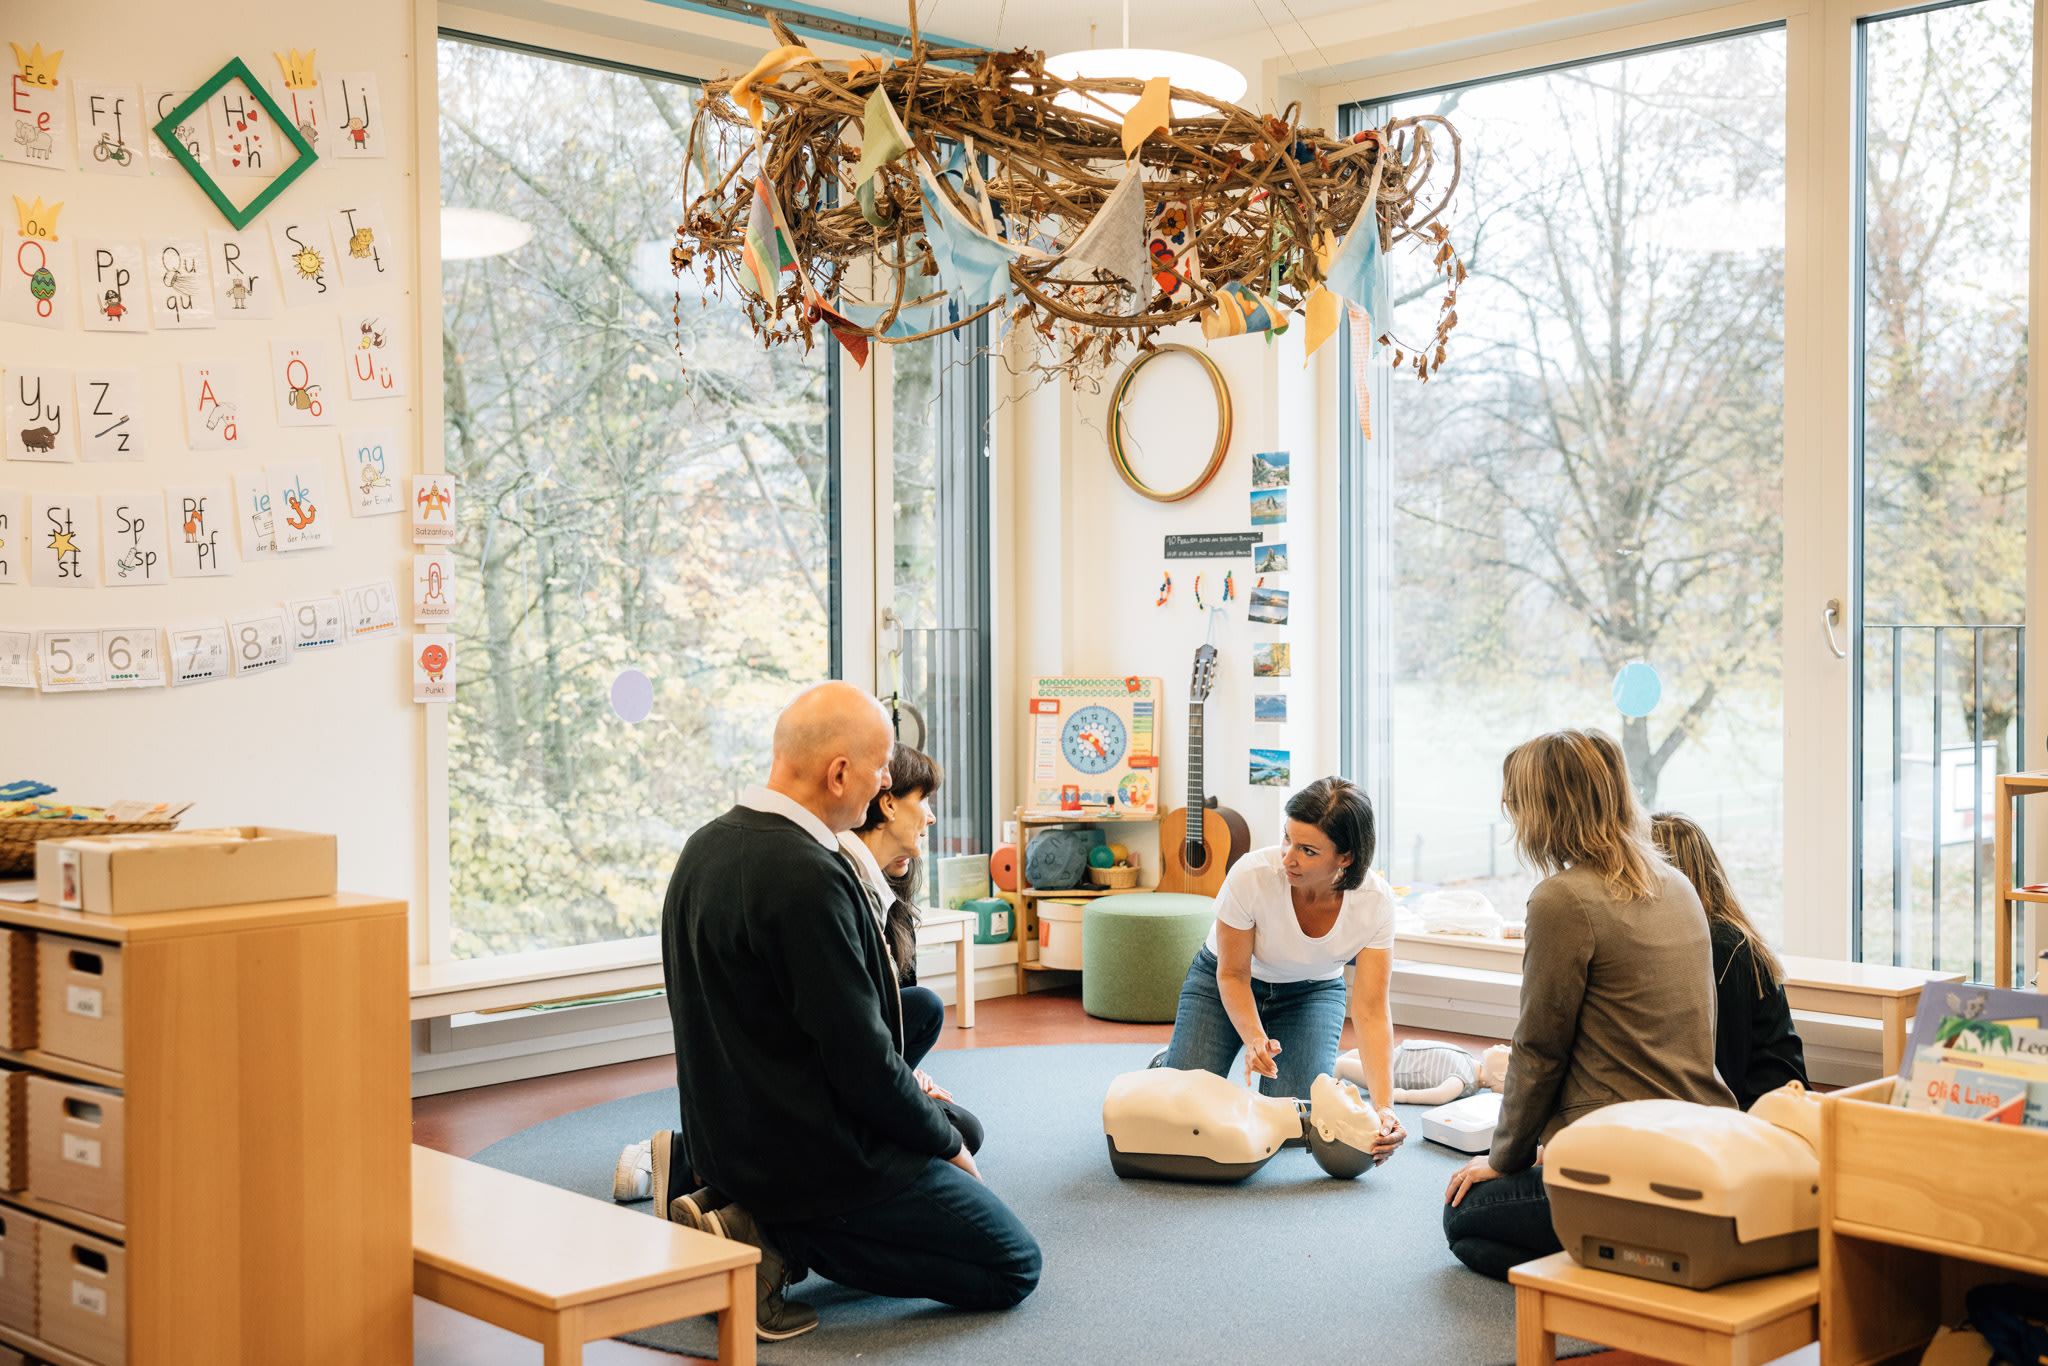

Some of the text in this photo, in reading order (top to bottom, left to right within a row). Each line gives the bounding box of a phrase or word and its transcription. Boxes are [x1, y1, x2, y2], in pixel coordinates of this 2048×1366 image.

[25, 65, 47, 85] Ee
[223, 95, 247, 127] H
[246, 136, 261, 168] h
[26, 220, 46, 237] Oo
[162, 247, 197, 274] Qu
[166, 295, 193, 323] qu
[358, 445, 385, 473] ng
[252, 488, 271, 512] ie
[283, 474, 311, 506] nk
[46, 507, 76, 538] St
[116, 506, 145, 545] Sp
[183, 497, 207, 537] Pf
[415, 527, 454, 538] Satzanfang
[58, 549, 82, 578] st
[197, 530, 219, 570] pf
[134, 551, 157, 579] sp
[353, 588, 380, 615] 10
[421, 607, 450, 615] Abstand
[297, 605, 317, 639] 9
[50, 638, 74, 674] 5
[108, 636, 131, 670] 6
[181, 635, 202, 670] 7
[241, 627, 262, 661] 8
[425, 686, 444, 694] Punkt
[1114, 736, 1119, 744] 3
[1102, 756, 1107, 764] 5
[1927, 1080, 1948, 1099] Oli
[1950, 1083, 1961, 1105] &
[1964, 1085, 2001, 1109] Livia
